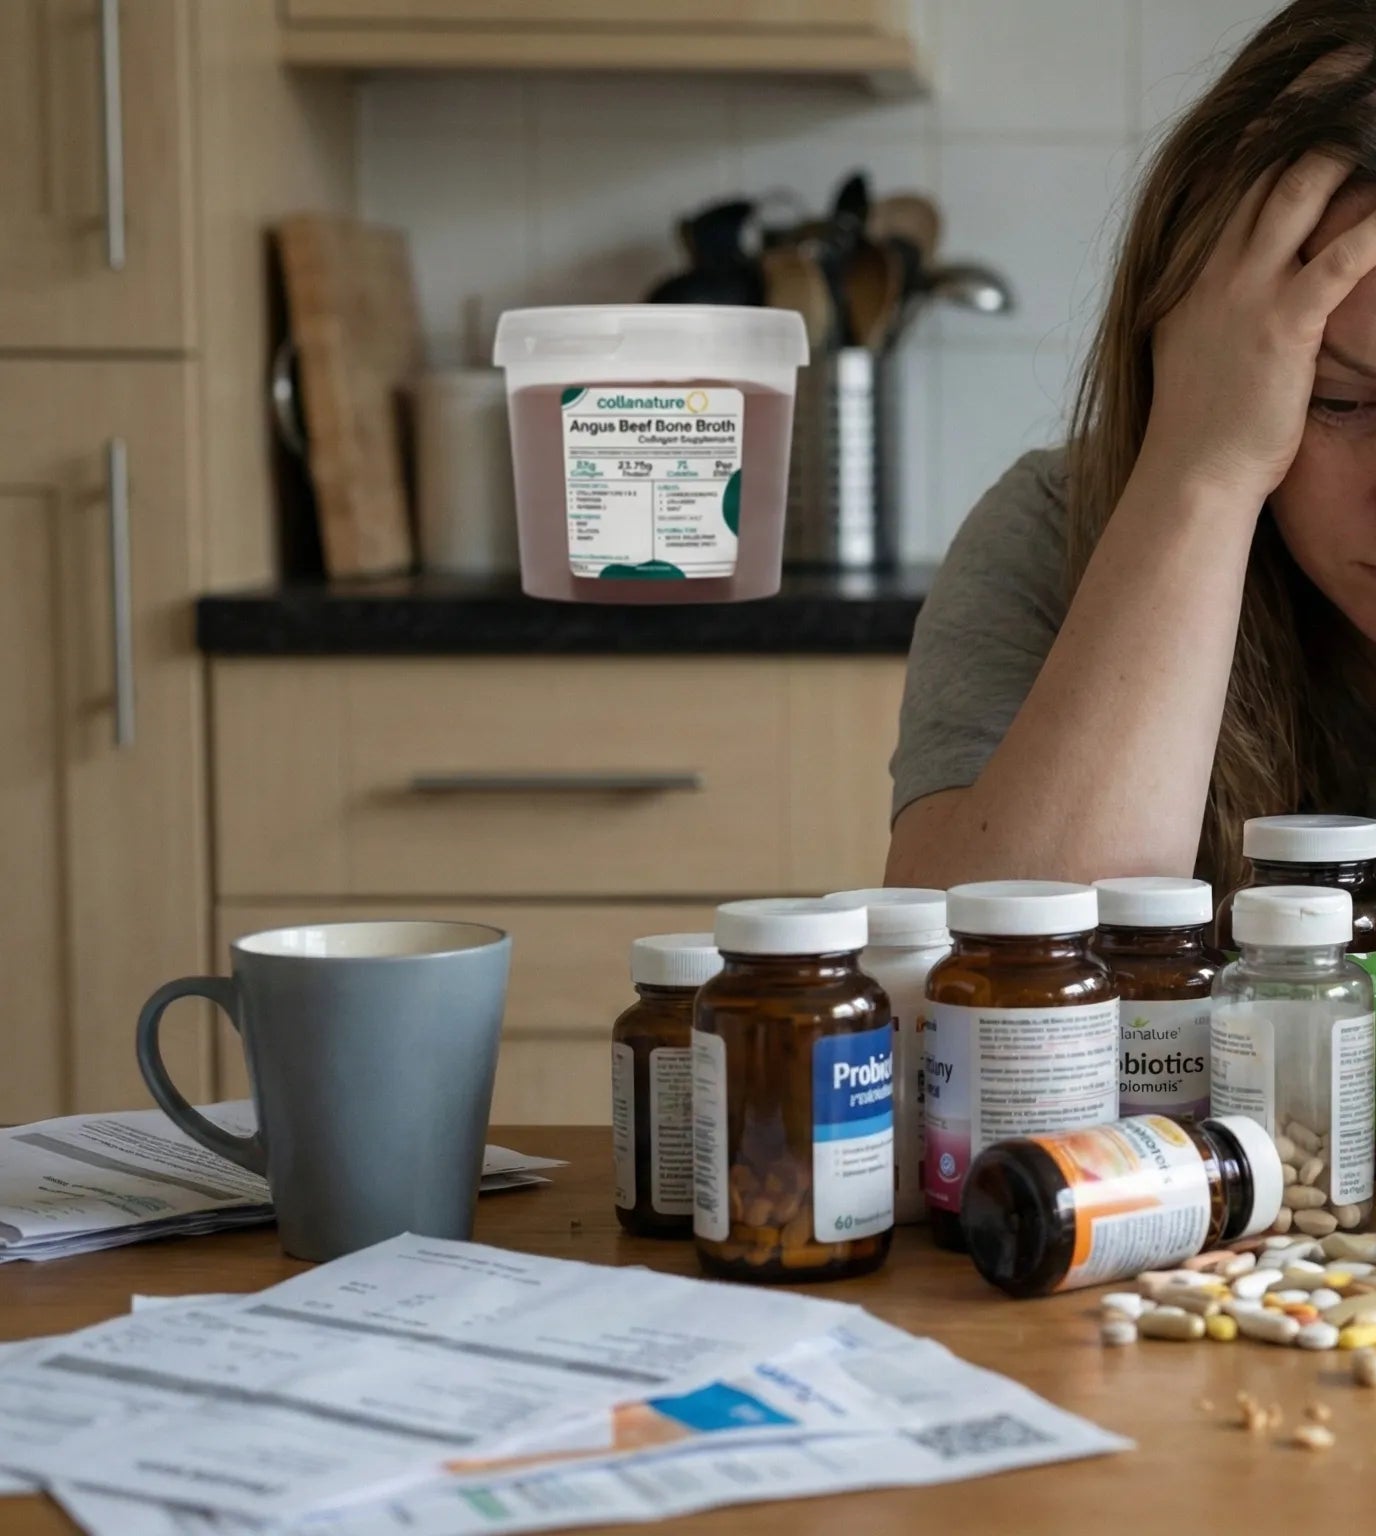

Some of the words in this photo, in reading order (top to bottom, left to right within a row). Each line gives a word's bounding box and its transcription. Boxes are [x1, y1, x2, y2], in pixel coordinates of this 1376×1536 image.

[597, 395, 685, 409] collanature
[570, 419, 616, 436] Angus
[619, 419, 652, 433] Beef
[656, 419, 692, 433] Bone
[696, 419, 735, 433] Broth
[1120, 1052, 1204, 1075] biotics
